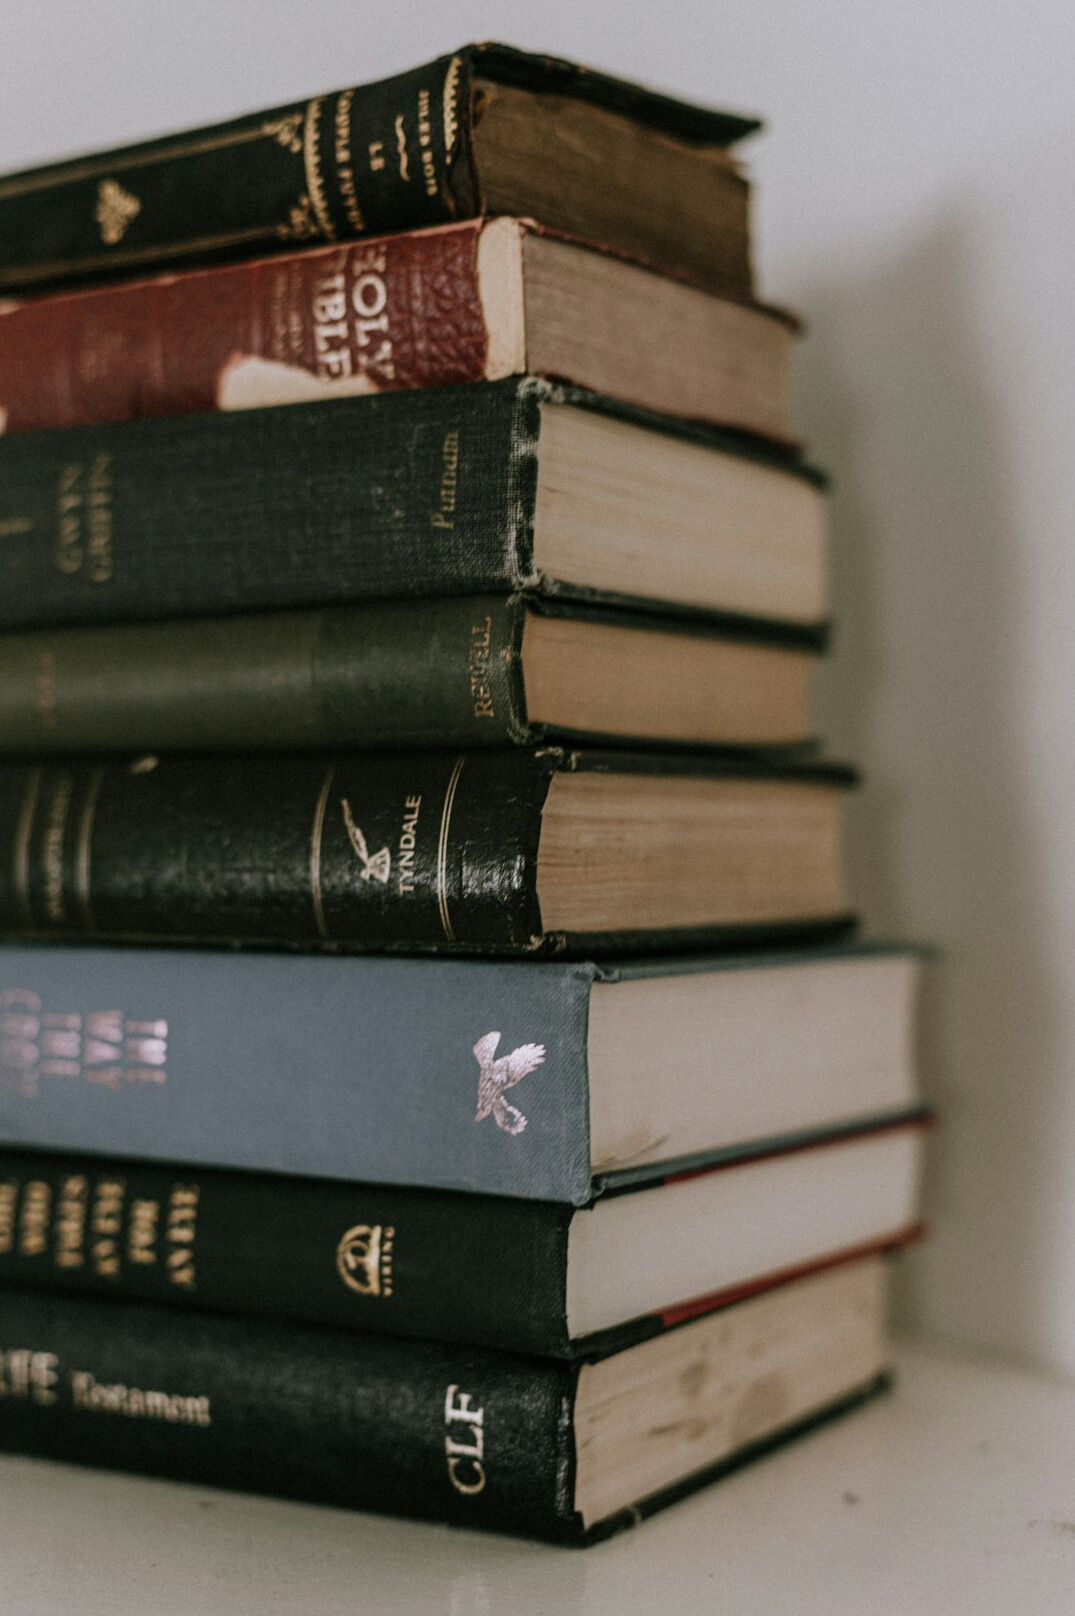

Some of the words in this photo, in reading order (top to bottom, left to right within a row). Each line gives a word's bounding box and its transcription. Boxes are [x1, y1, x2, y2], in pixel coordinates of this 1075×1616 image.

[352, 244, 395, 380] HOLY
[430, 431, 459, 529] Putnam
[399, 795, 422, 896] TYNDALE
[444, 1383, 486, 1494] CLF
